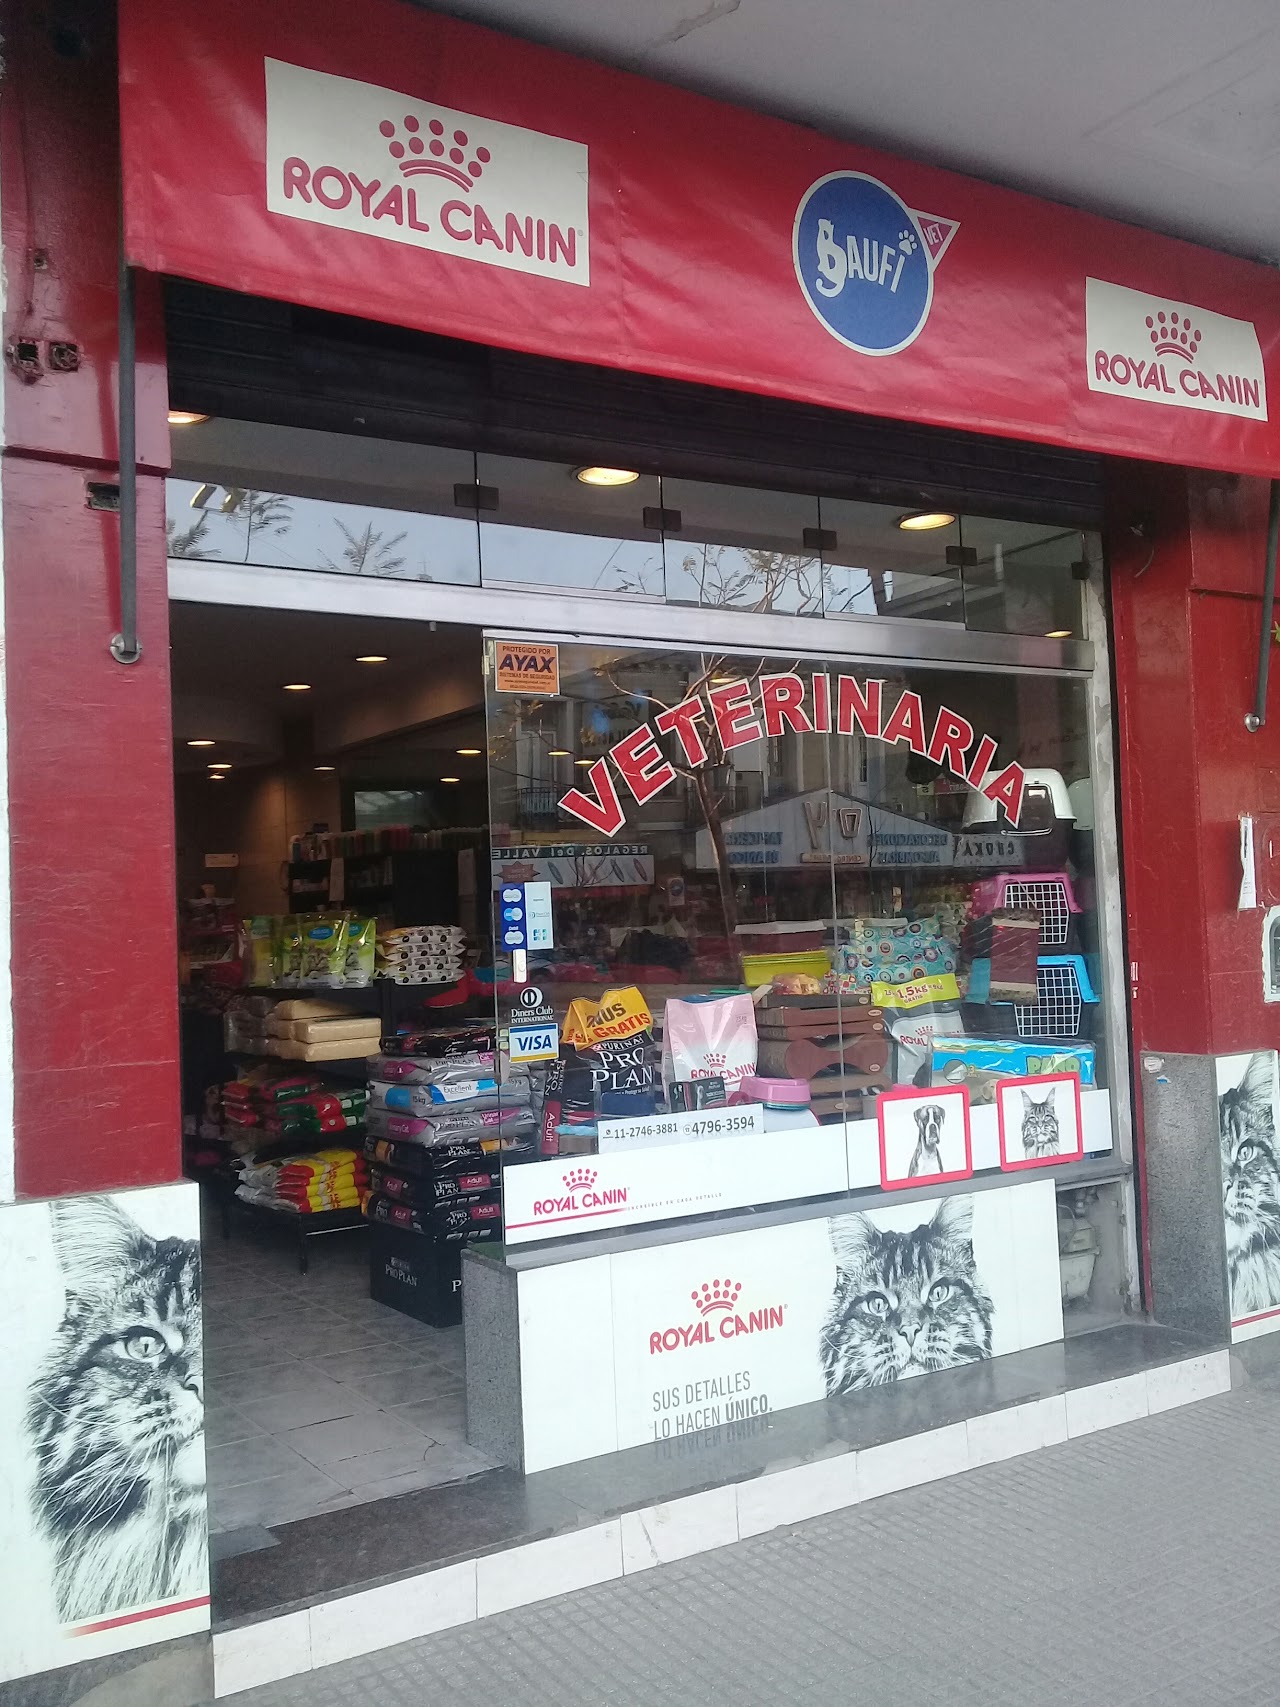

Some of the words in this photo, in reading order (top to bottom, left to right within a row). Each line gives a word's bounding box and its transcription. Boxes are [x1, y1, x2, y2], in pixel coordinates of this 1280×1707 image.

[283, 157, 430, 232] ROYAL
[440, 200, 576, 267] CANIN
[924, 223, 943, 245] VET
[1095, 350, 1175, 393] ROYAL
[1179, 369, 1259, 408] CANIN
[499, 653, 556, 674] AYAX
[556, 672, 1026, 838] VETERINARIA
[511, 1008, 535, 1018] Diners
[535, 1005, 553, 1016] Club
[511, 1015, 554, 1023] INTERNATIONAL
[593, 1013, 651, 1038] GRATIS
[515, 1034, 552, 1051] VISA
[601, 1036, 642, 1050] PURINA
[596, 1047, 644, 1070] PRO
[590, 1066, 653, 1091] PLAN
[720, 1061, 756, 1080] CANIN
[443, 1084, 473, 1094] Excellent
[545, 1113, 556, 1142] Adult
[614, 1122, 678, 1139] 11-2746-3881
[691, 1115, 755, 1135] 4796-3594
[533, 1195, 579, 1216] ROYAL
[582, 1187, 627, 1207] CANIN
[650, 1321, 715, 1354] ROYAL
[720, 1305, 783, 1338] CANIN
[653, 1387, 680, 1412] SUS
[685, 1371, 751, 1404] DETALLES
[654, 1418, 670, 1441] LO
[676, 1405, 720, 1435] HACEN
[725, 1394, 773, 1422] ÚNICO.
